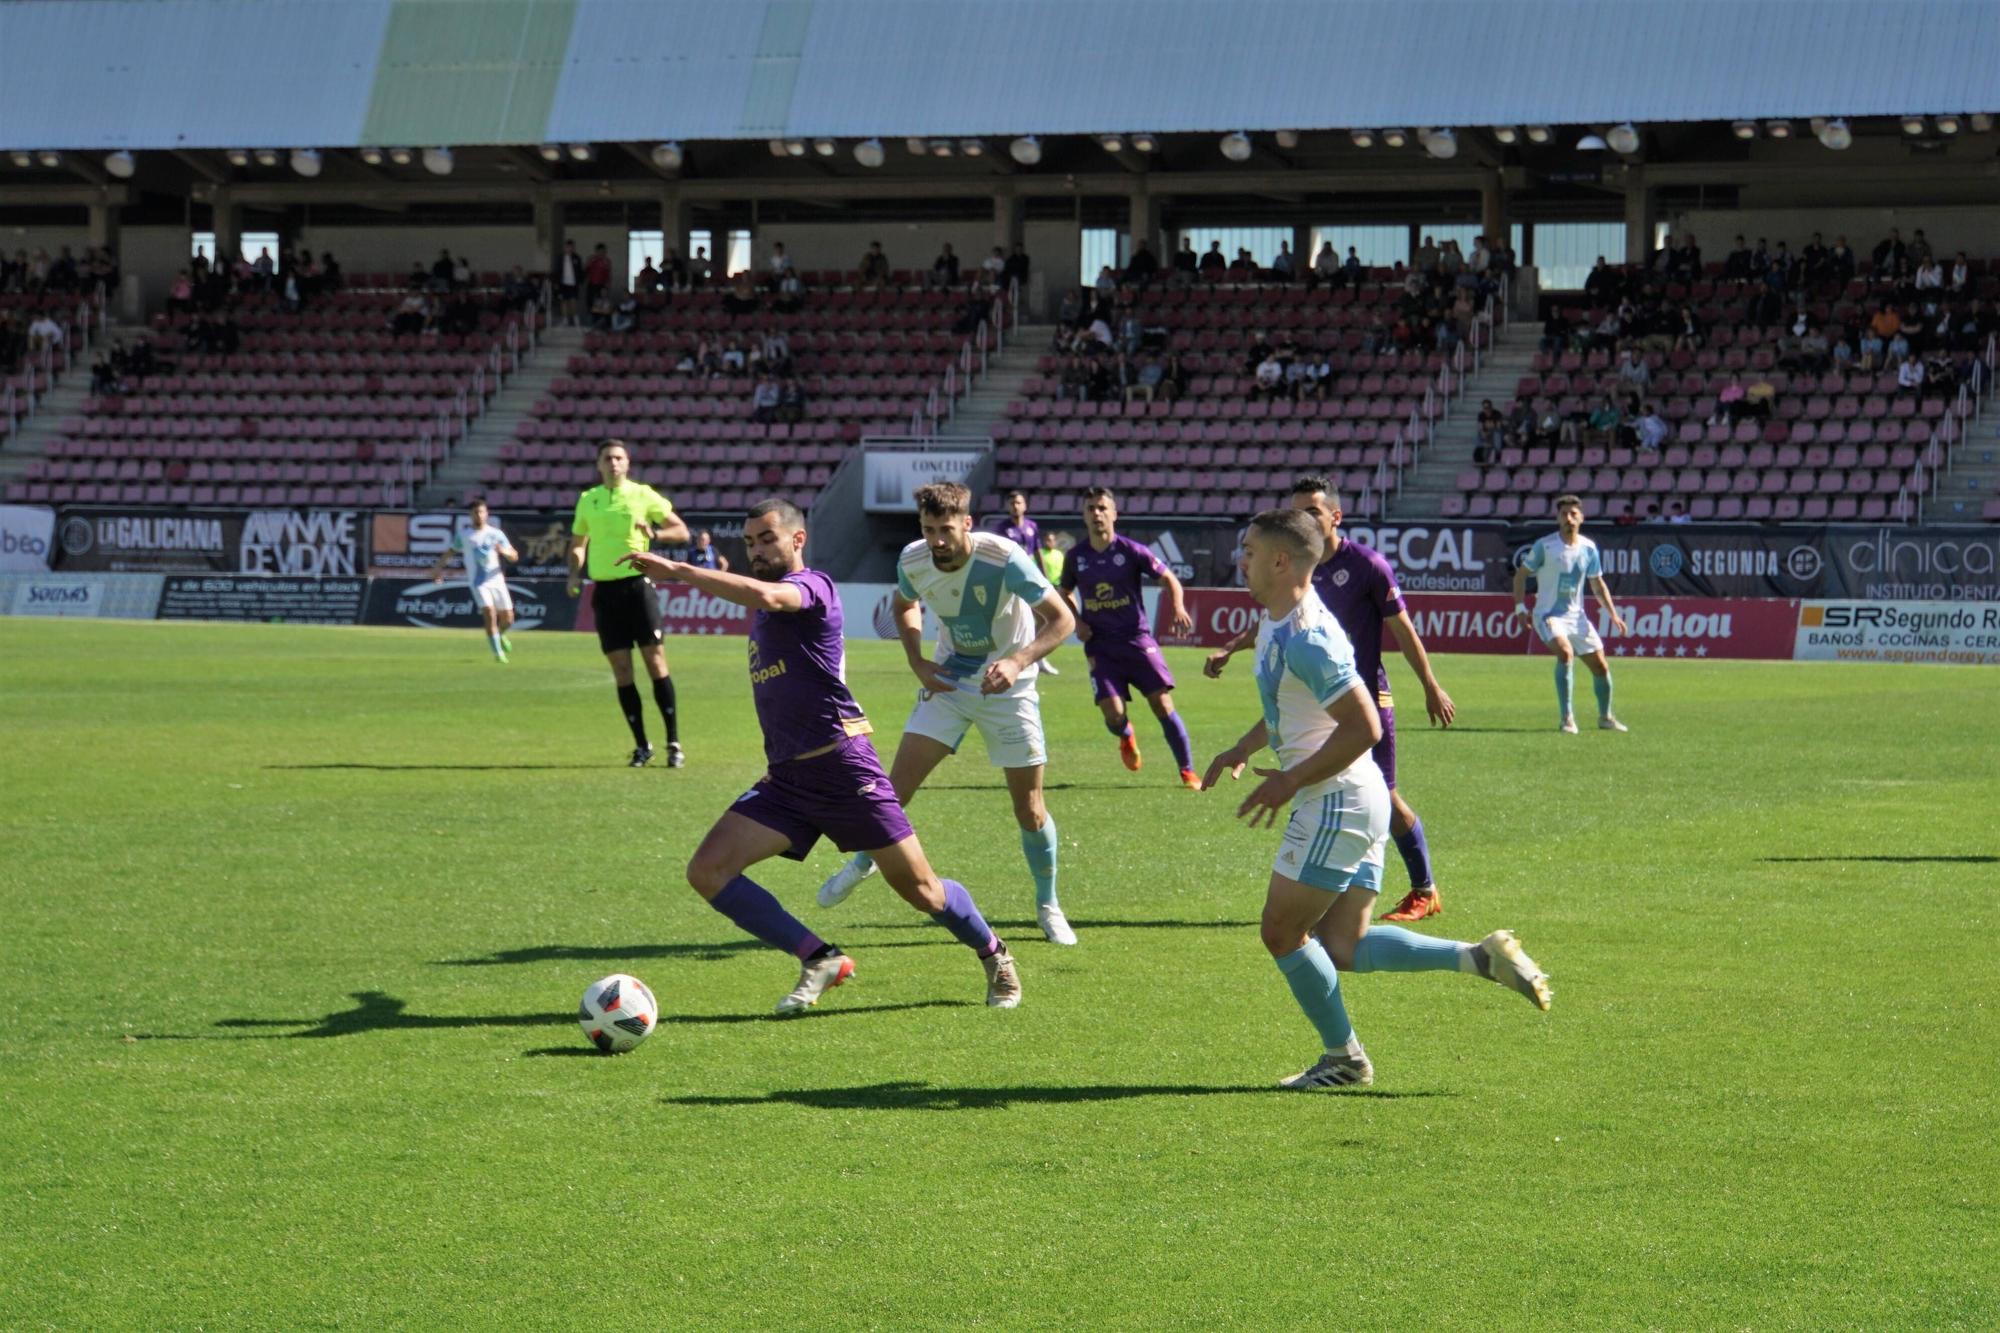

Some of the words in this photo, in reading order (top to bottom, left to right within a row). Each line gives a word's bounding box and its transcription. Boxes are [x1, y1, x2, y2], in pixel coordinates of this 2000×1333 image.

[117, 517, 224, 550] GALICIANA
[1691, 550, 1779, 576] SEGUNDA
[1865, 584, 1945, 600] INSTITUTO
[1883, 607, 1976, 633] Segundo
[1877, 634, 1950, 648] COCINAS
